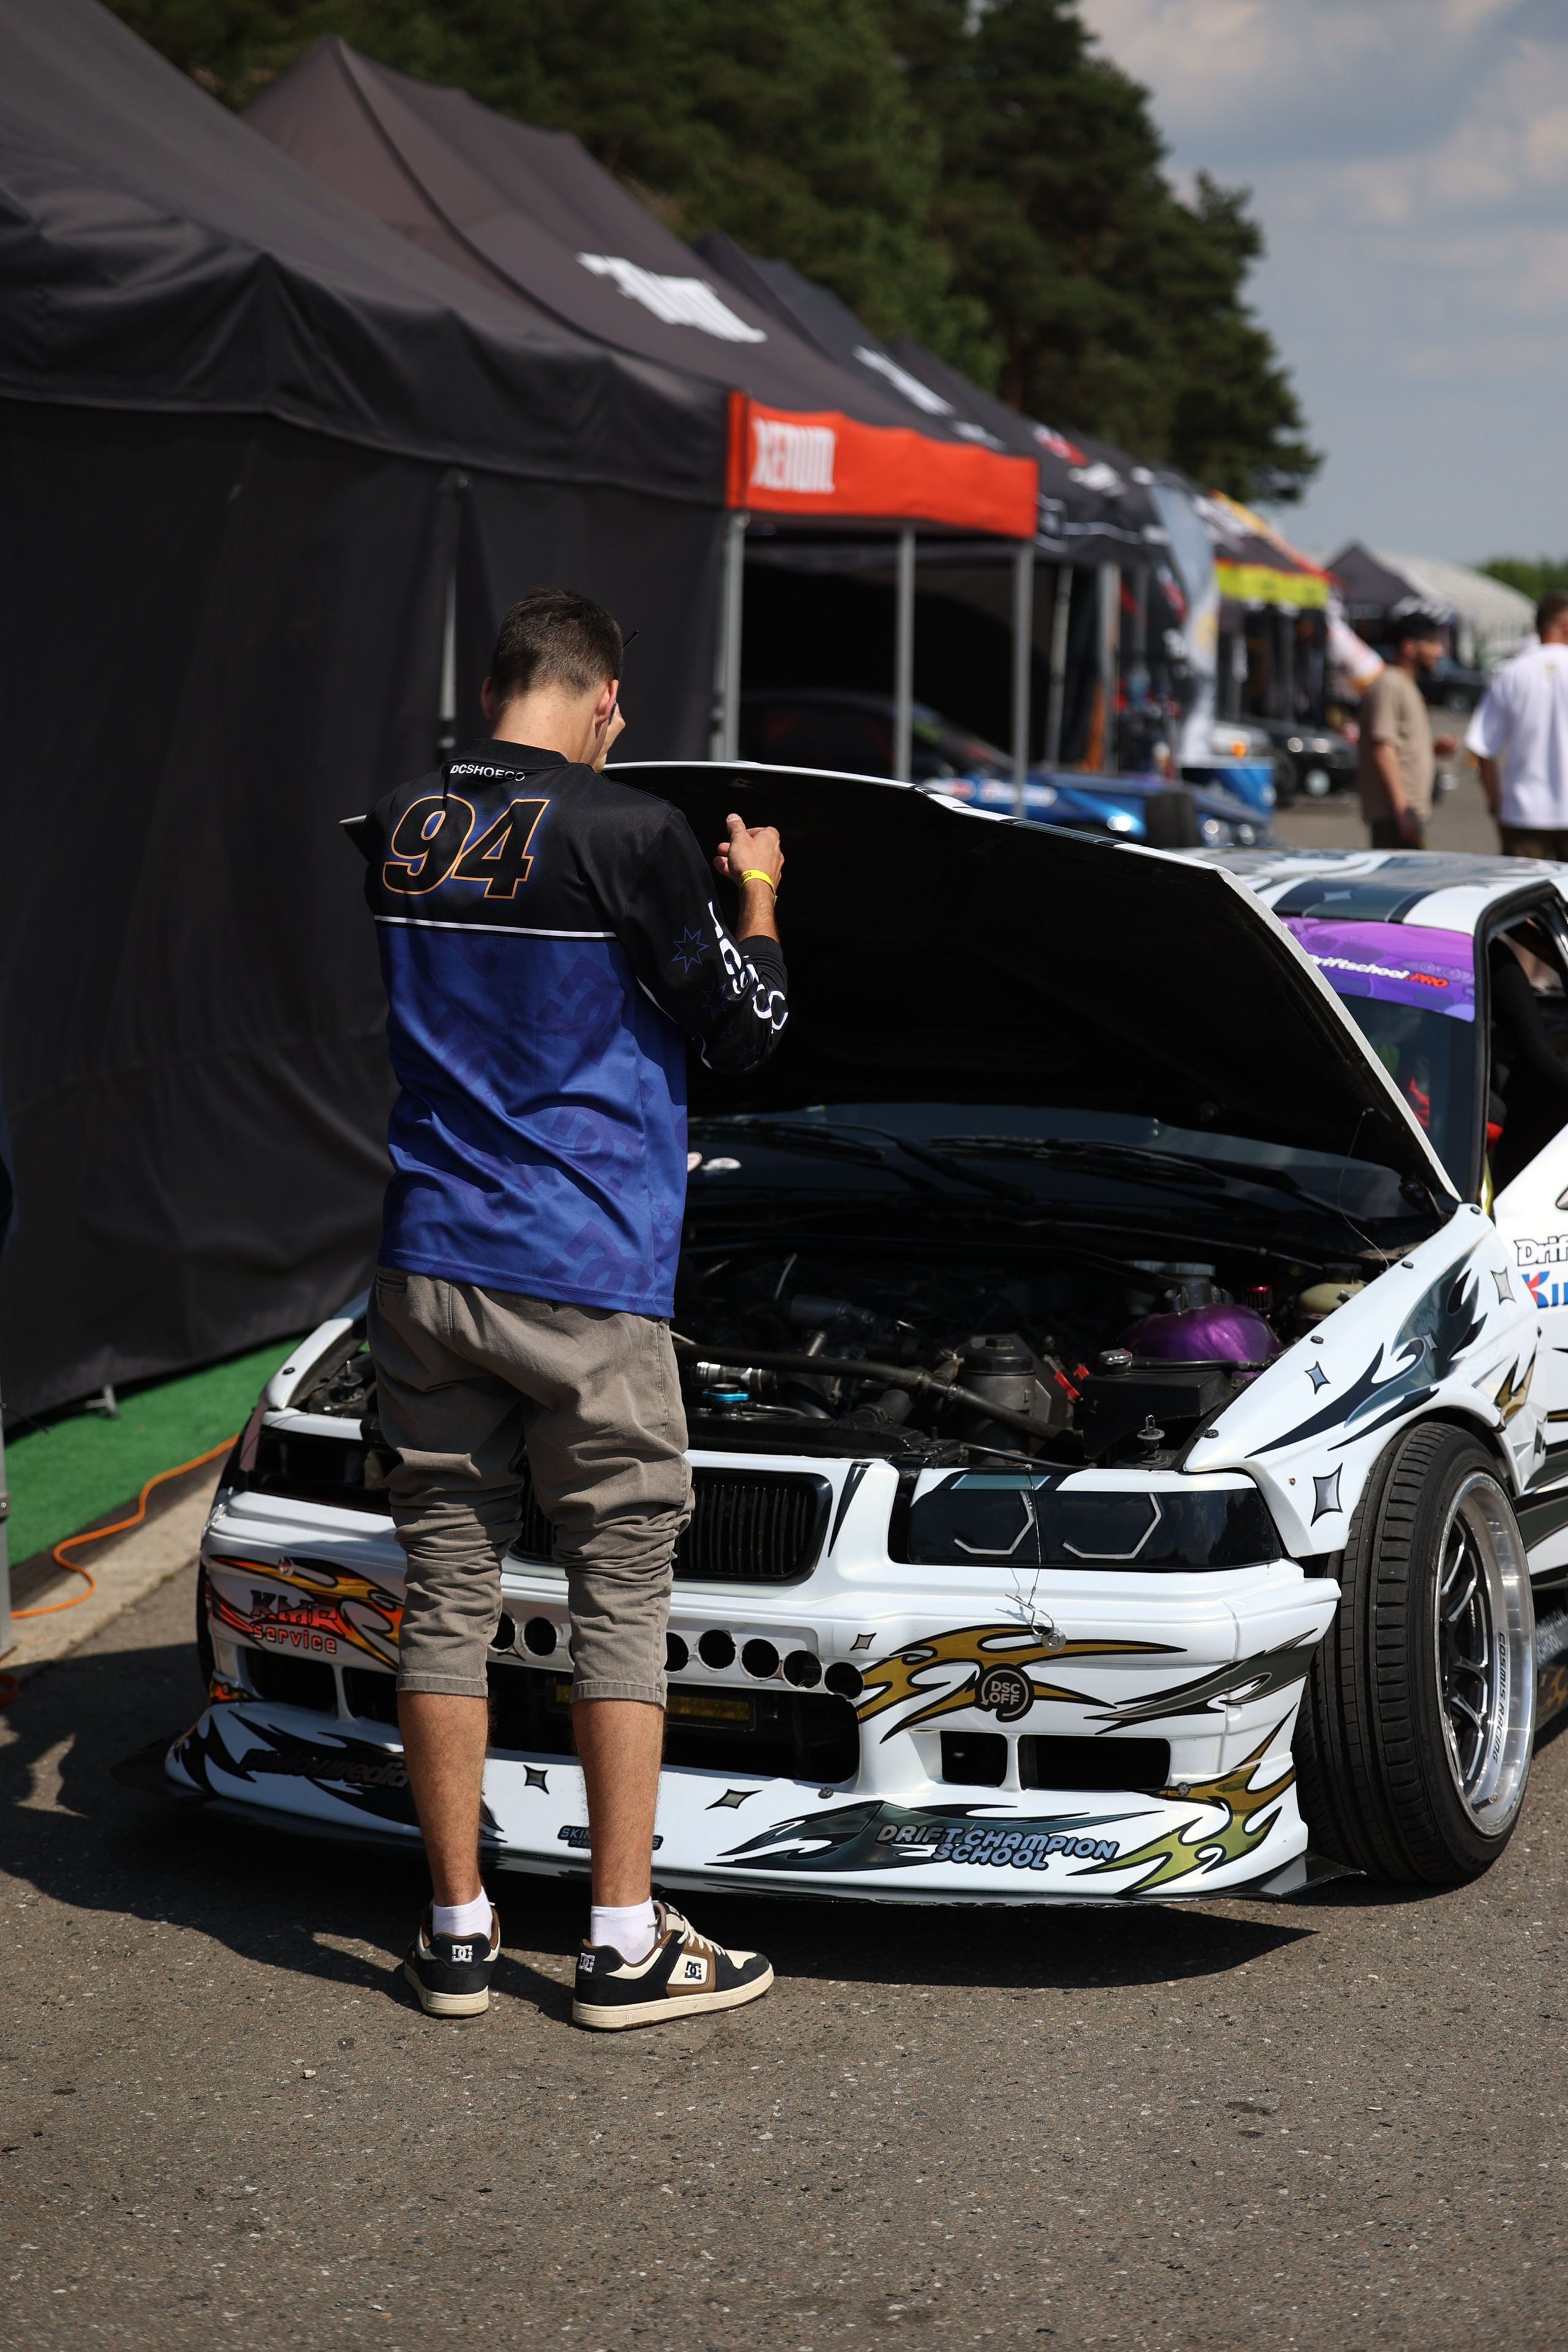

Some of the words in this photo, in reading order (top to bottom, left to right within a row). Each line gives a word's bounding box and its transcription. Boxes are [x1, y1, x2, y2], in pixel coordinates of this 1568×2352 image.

[449, 764, 526, 782] DCSHOECO
[382, 793, 551, 899] 94
[253, 1624, 337, 1654] service
[1499, 1632, 1507, 1701] COSMIS
[989, 1692, 1020, 1705] OFF
[991, 1680, 1021, 1695] DSC
[1492, 1700, 1504, 1765] RACING
[876, 1824, 963, 1843] DRIFT
[963, 1829, 1120, 1860] CHAMPION
[934, 1842, 1049, 1869] SCHOOL
